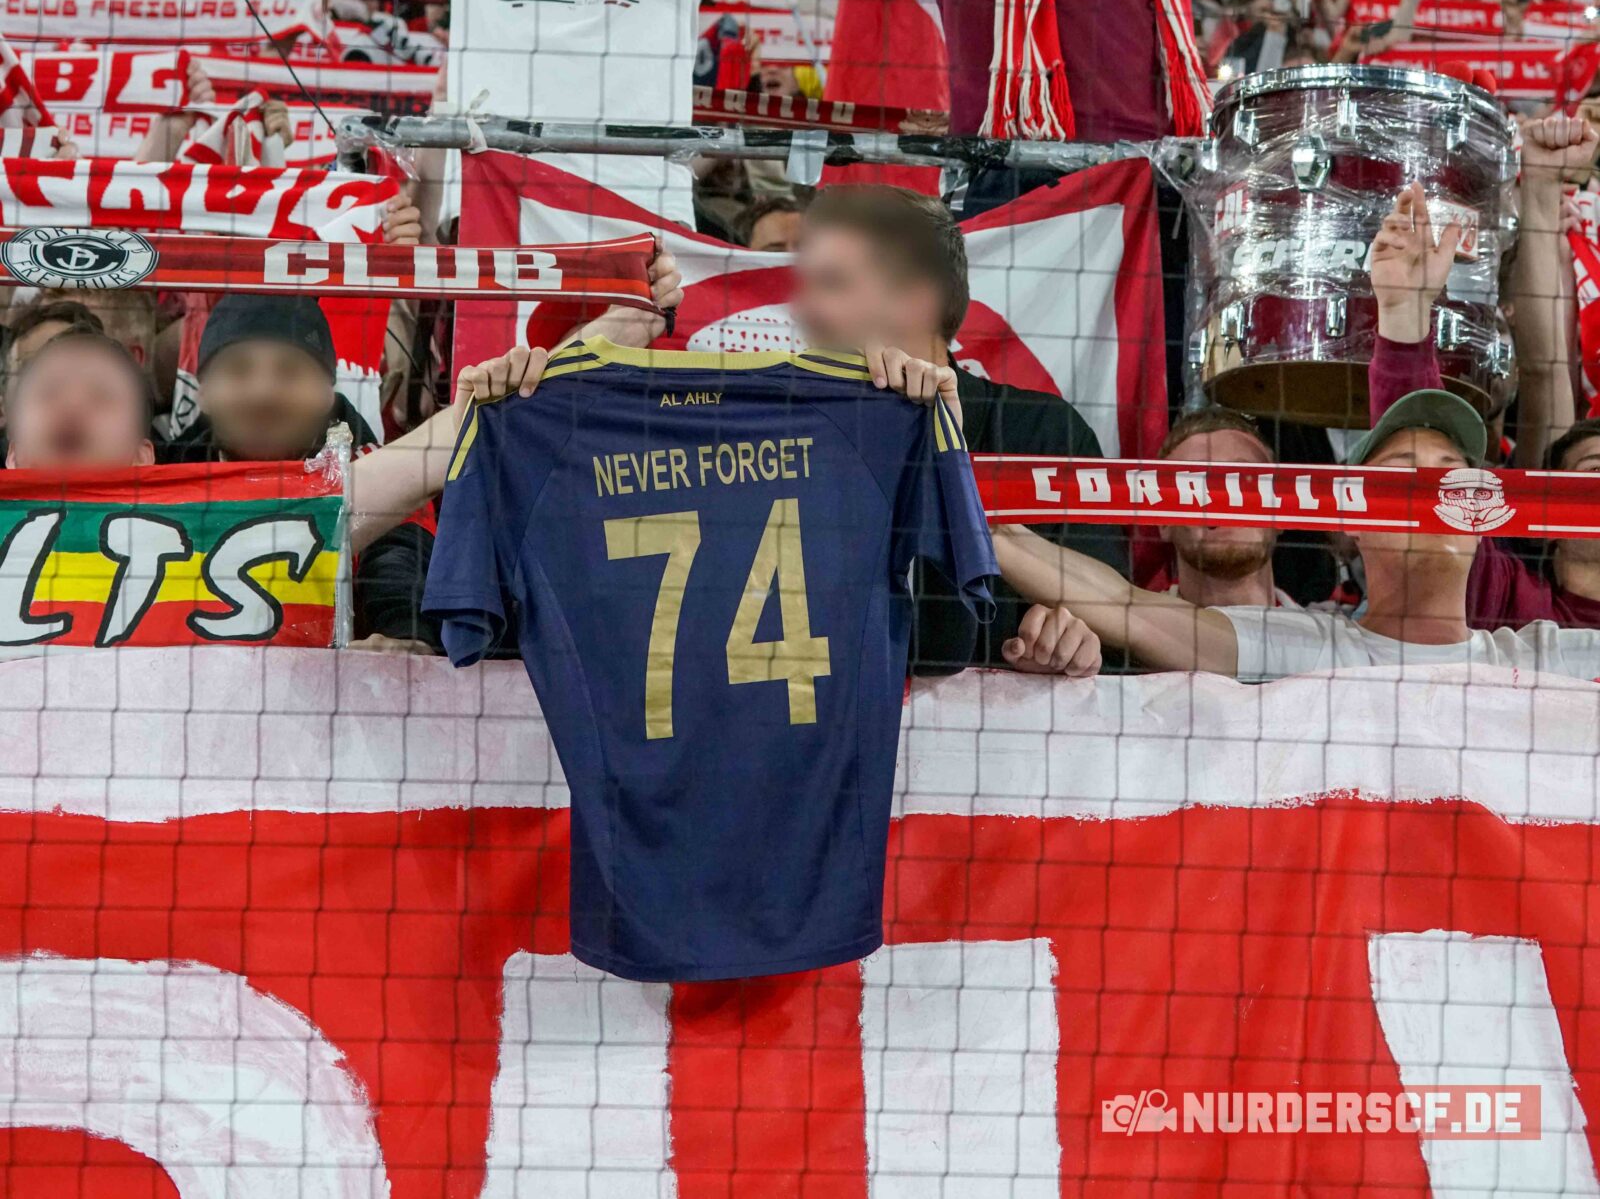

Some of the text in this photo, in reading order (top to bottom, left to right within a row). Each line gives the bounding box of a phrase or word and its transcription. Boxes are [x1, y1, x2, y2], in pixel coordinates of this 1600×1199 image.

[13, 257, 140, 289] FREIBURG
[263, 241, 563, 290] CLUB
[660, 391, 723, 408] AL AHLY
[593, 437, 813, 497] NEVER FORGET
[1031, 467, 1368, 513] CORRILLO
[603, 498, 831, 740] 74
